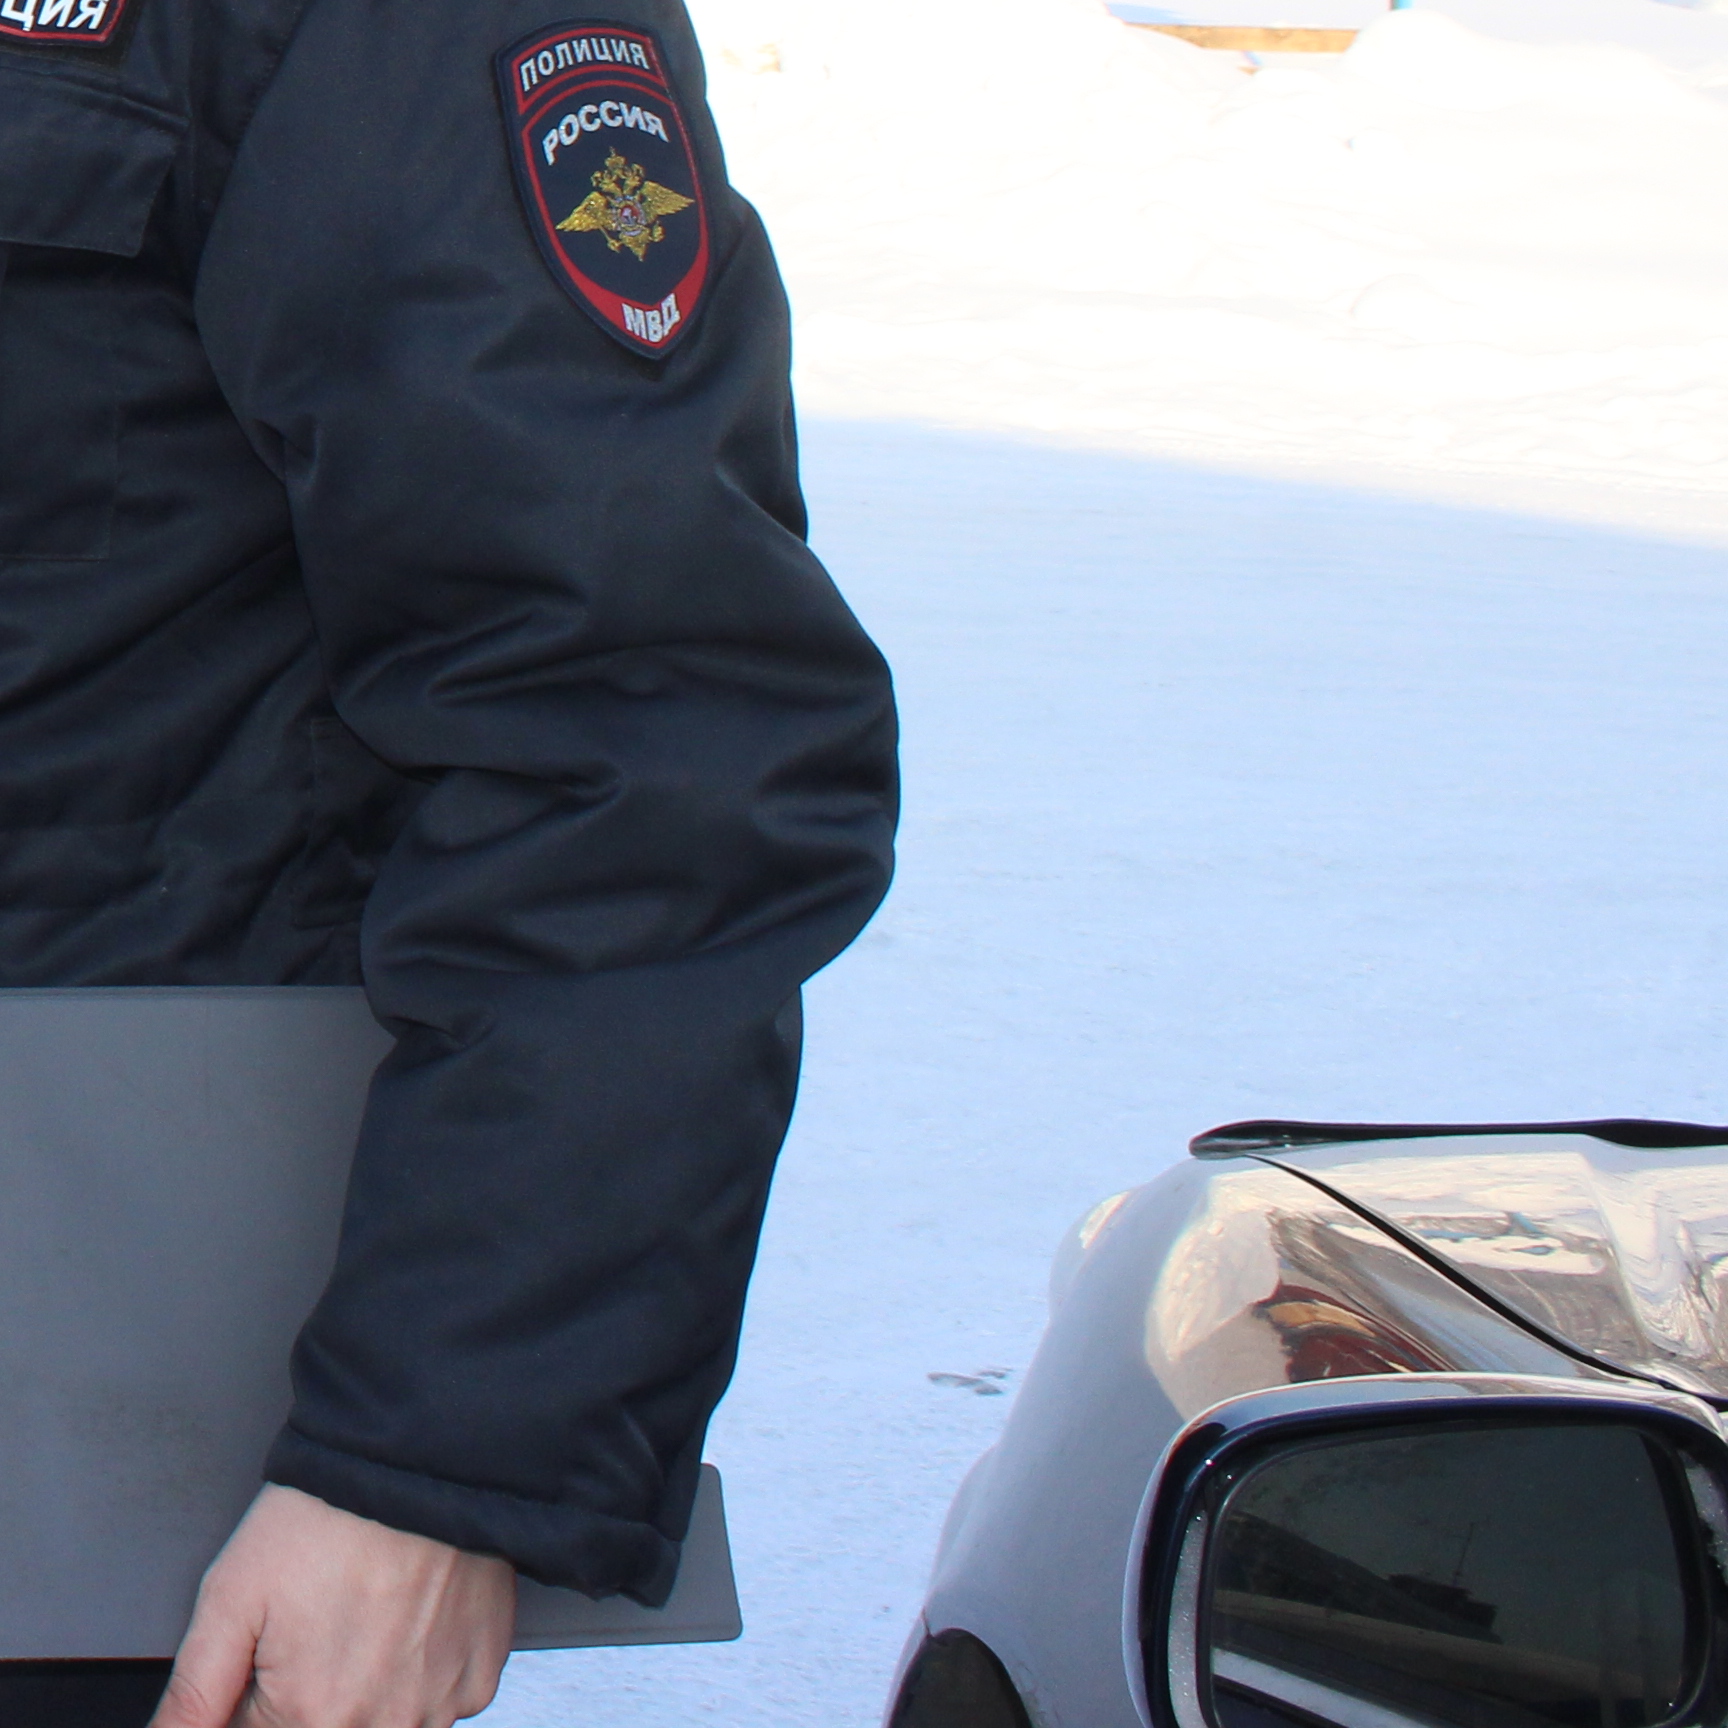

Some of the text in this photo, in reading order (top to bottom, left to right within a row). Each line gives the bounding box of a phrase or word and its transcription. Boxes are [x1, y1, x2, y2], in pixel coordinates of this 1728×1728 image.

[519, 36, 651, 92] ПОЛИЦИЯ
[542, 99, 671, 165] РОССИЯ
[622, 293, 681, 343] МВД
